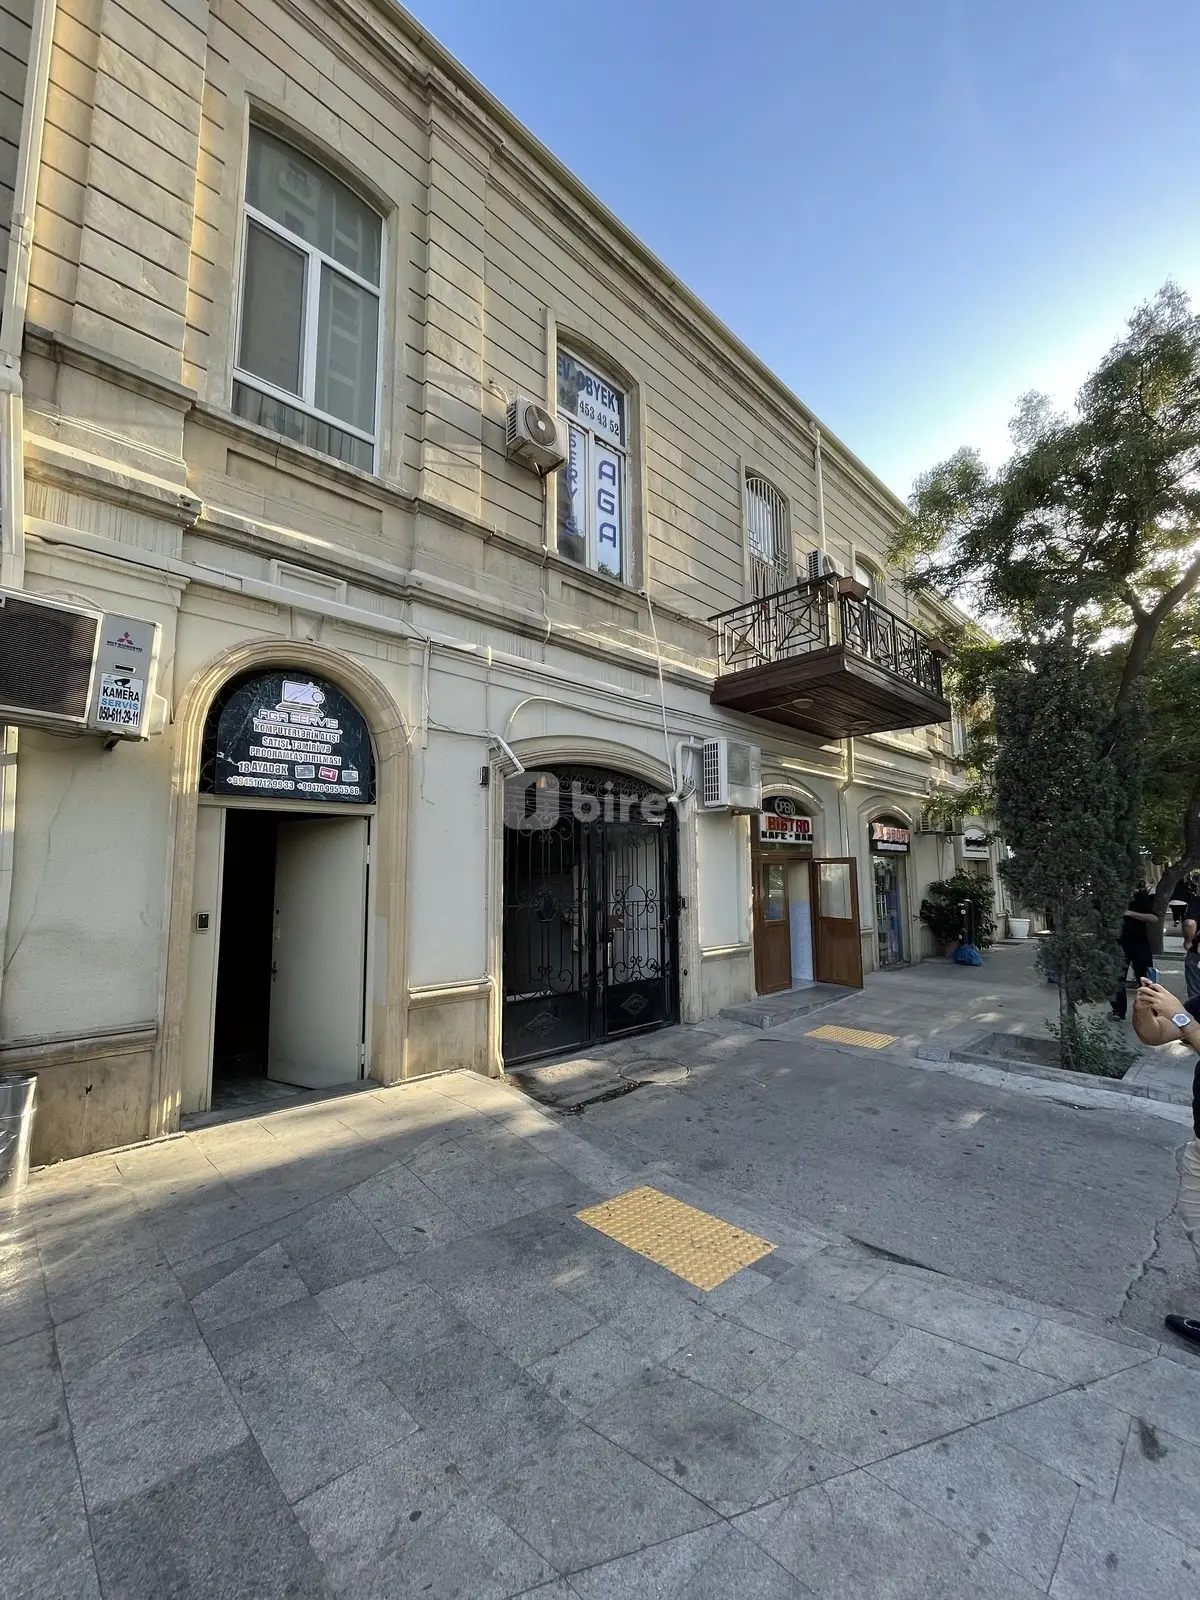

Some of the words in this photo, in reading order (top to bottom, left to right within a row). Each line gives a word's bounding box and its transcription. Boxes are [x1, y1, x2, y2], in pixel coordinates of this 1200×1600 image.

[579, 400, 596, 421] 453
[609, 418, 620, 437] 52
[597, 459, 617, 549] AGA
[102, 685, 140, 702] KAMERA
[101, 698, 139, 711] SERVİS
[99, 706, 139, 725] 050-611-29-11
[258, 708, 289, 723] AGA
[290, 711, 339, 729] SERVIS
[239, 761, 251, 773] 18
[251, 761, 288, 775] AYADƏK
[776, 800, 795, 816] OPEN
[761, 830, 787, 840] KAFE
